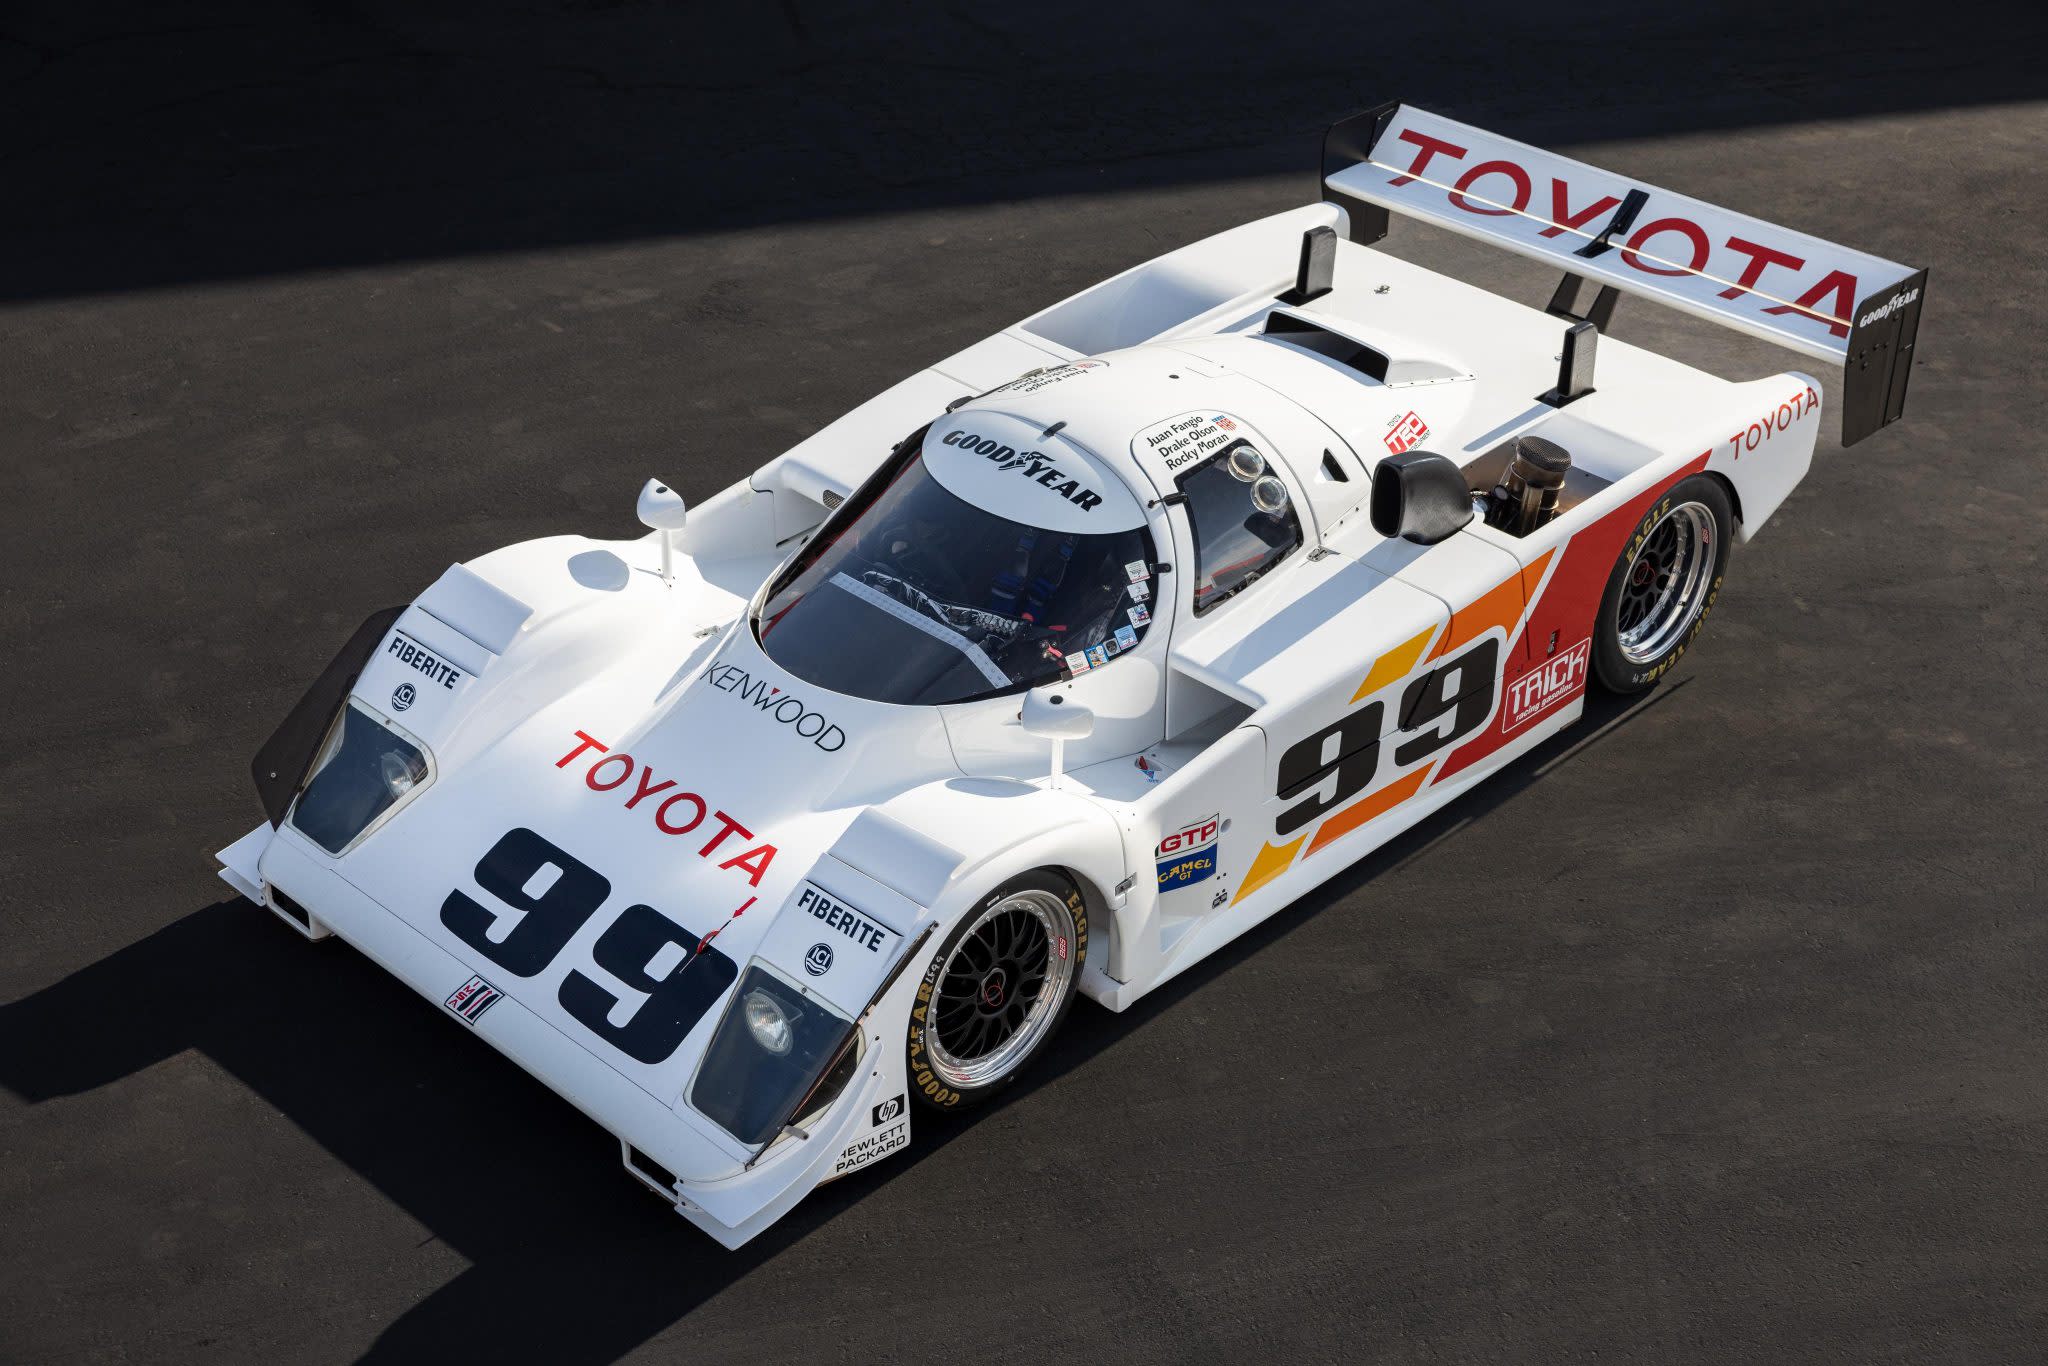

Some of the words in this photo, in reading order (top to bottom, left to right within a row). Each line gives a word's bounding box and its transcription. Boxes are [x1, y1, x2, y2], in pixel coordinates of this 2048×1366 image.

[1387, 128, 1858, 339] TOYOTA
[1859, 288, 1919, 328] GOODYEAR
[1146, 429, 1173, 448] Juan
[1170, 416, 1204, 434] Fangio
[1158, 437, 1190, 457] Drake
[1188, 424, 1218, 441] Olson
[1165, 449, 1200, 471] Rocky
[1197, 433, 1229, 453] Moran
[1730, 386, 1819, 461] TOYOTA
[942, 430, 1103, 512] GOODYEAR
[1626, 498, 1670, 562] EAGLE
[388, 636, 460, 690] FIBERITE
[1511, 644, 1586, 714] TRICK
[700, 661, 846, 752] KENWOOD
[1515, 701, 1541, 721] racing
[1540, 682, 1573, 708] gasoline
[1276, 637, 1499, 836] 99
[555, 730, 778, 888] TOYOTA
[1161, 820, 1217, 853] GTP
[1157, 858, 1212, 883] CAMEL
[1180, 870, 1192, 880] GT
[439, 827, 739, 1064] 99
[798, 888, 886, 953] FIBERITE
[1066, 889, 1086, 962] EAGLE
[448, 981, 481, 1009] IMSA
[910, 981, 961, 1107] GOODYEAR
[882, 1100, 896, 1121] hp
[836, 1135, 906, 1173] PACKARD
